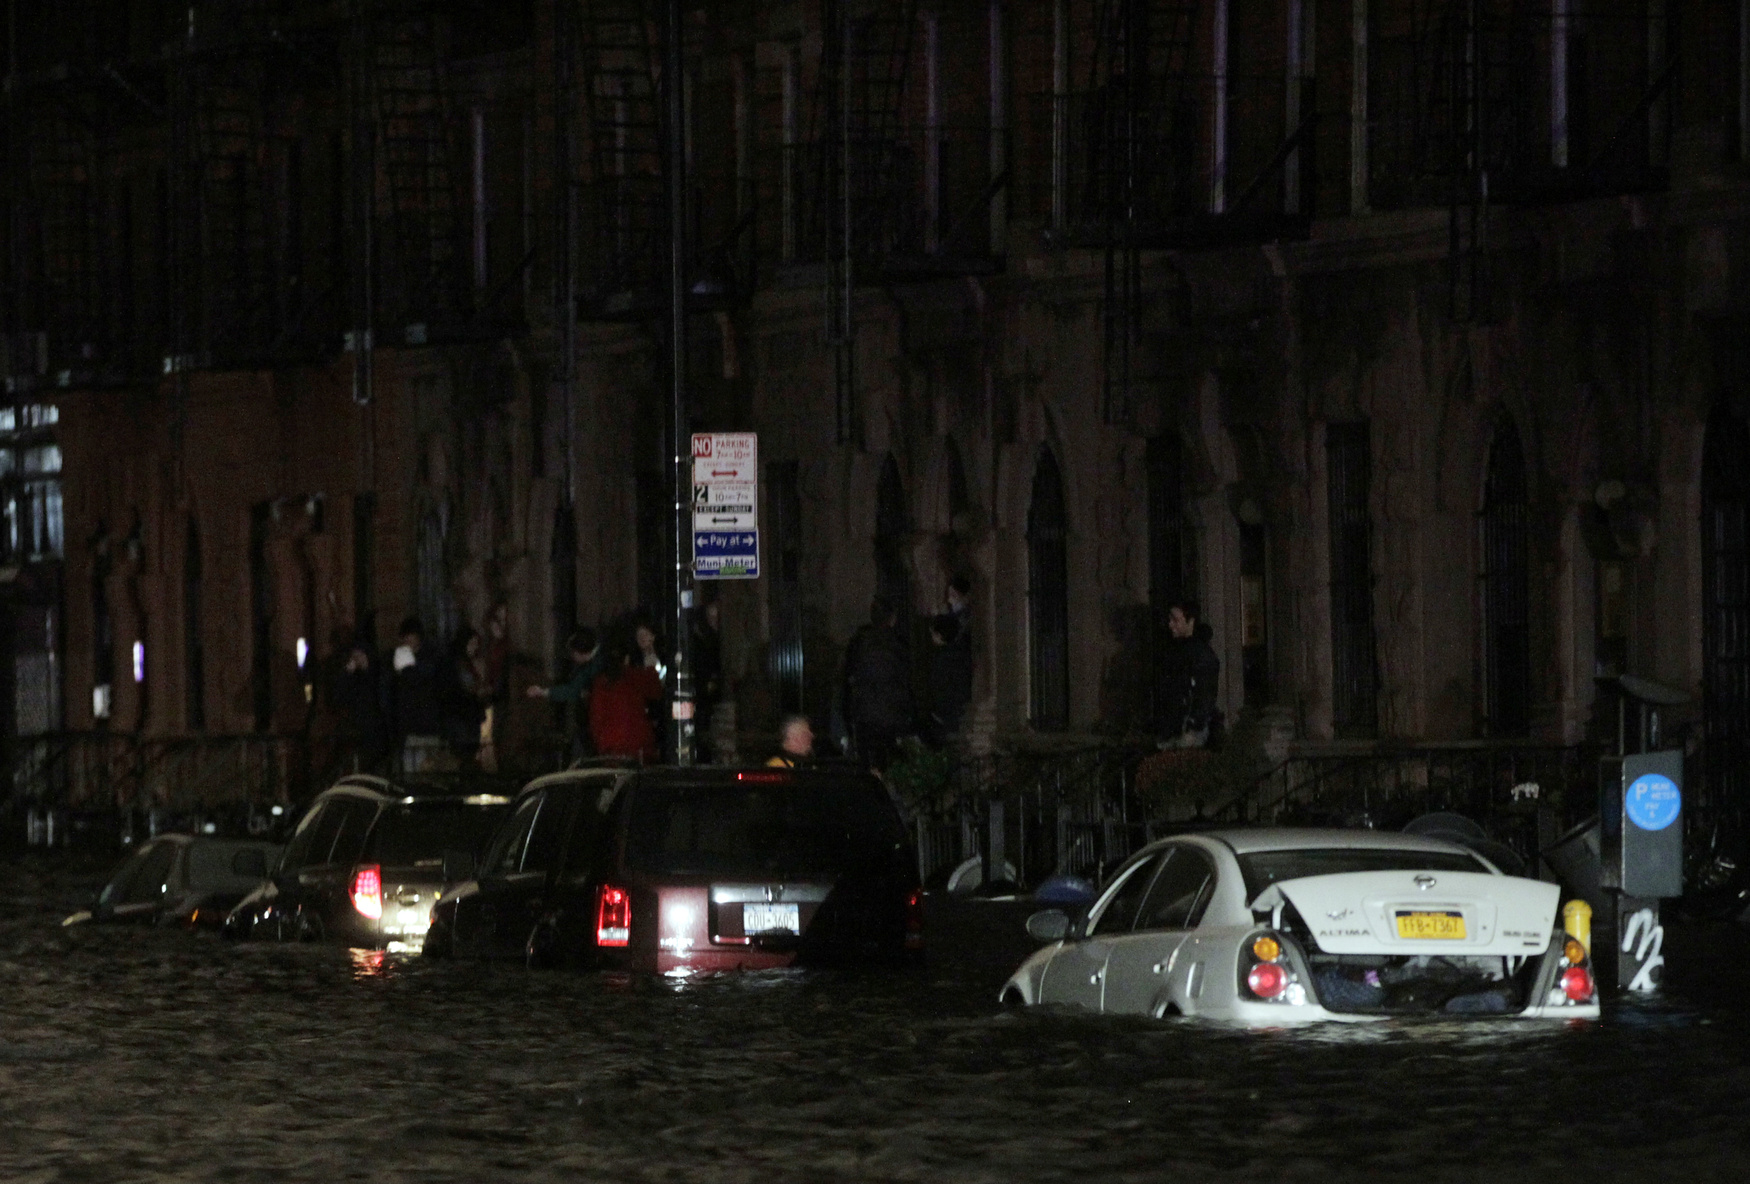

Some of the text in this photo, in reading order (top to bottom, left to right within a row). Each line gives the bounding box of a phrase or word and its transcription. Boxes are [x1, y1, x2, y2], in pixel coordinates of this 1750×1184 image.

[694, 438, 711, 455] NO
[716, 438, 750, 448] PARKING
[696, 485, 706, 502] 2
[710, 533, 740, 549] Pay at
[1635, 782, 1648, 801] P
[1319, 929, 1371, 937] ALTIMA
